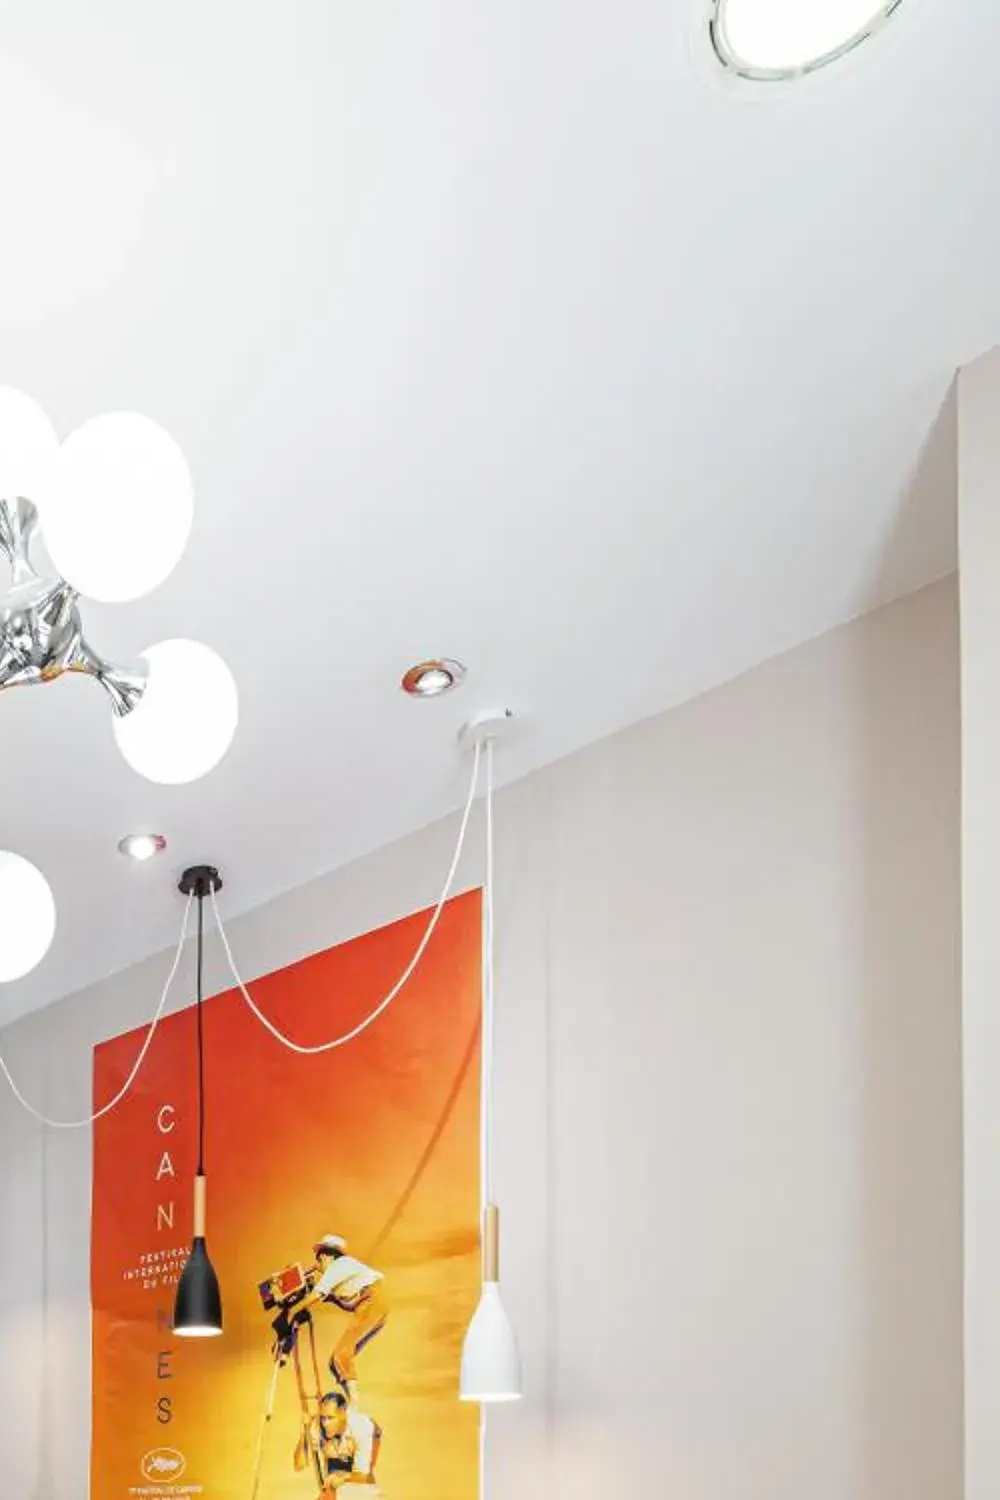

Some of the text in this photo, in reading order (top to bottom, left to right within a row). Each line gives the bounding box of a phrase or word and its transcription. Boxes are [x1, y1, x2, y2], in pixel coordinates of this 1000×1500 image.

[140, 1247, 191, 1264] FESTIVAL
[123, 1260, 188, 1280] INTERNATIO
[162, 1275, 180, 1285] FIL
